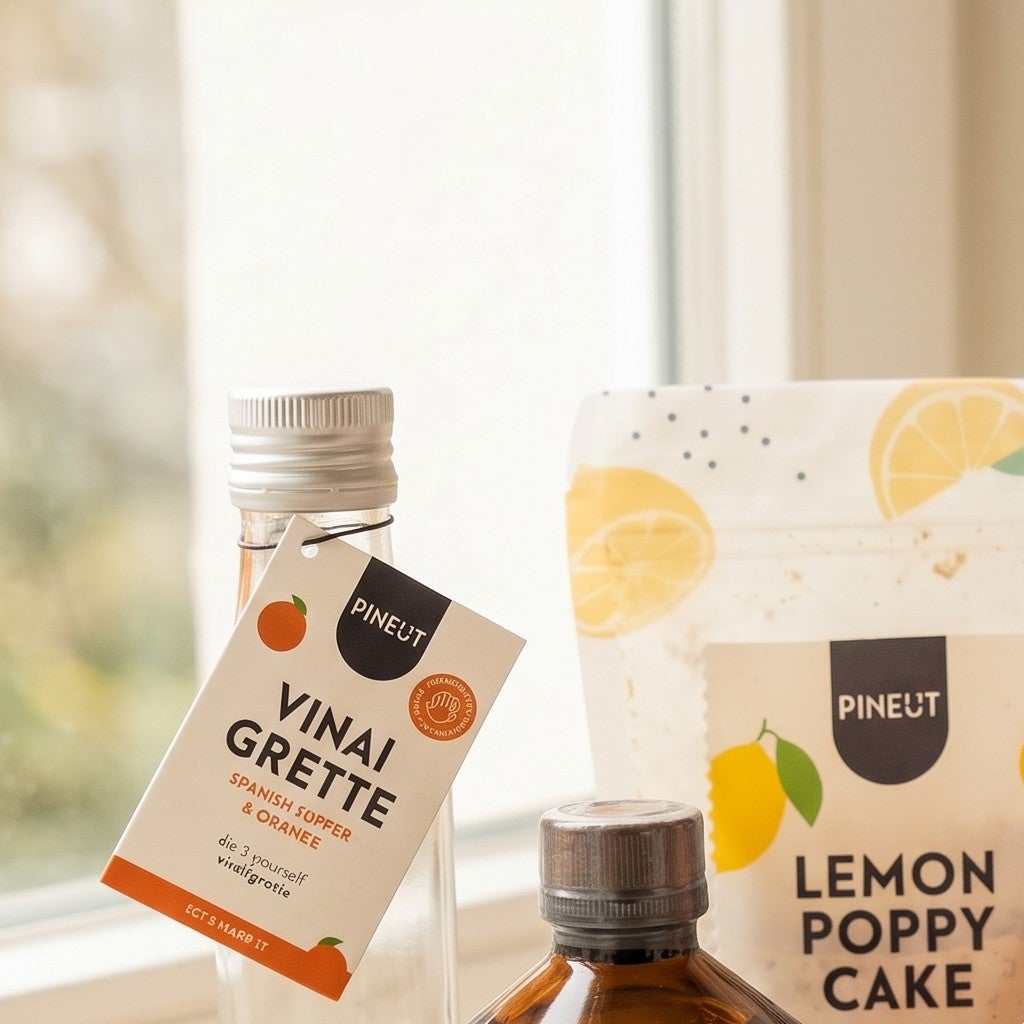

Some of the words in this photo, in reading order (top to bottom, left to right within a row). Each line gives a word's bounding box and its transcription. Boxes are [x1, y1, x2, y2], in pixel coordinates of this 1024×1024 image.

[350, 597, 427, 648] PINEUT
[280, 681, 396, 773] VINAI
[838, 691, 941, 721] PINEUT
[226, 719, 398, 829] GRETTE
[229, 773, 294, 812] SPANISH
[218, 834, 237, 852] die
[242, 801, 252, 815] &
[256, 809, 322, 850] ORANEE
[796, 850, 996, 899] LEMON
[802, 906, 995, 955] POPPY
[823, 963, 974, 1011] CAKE
